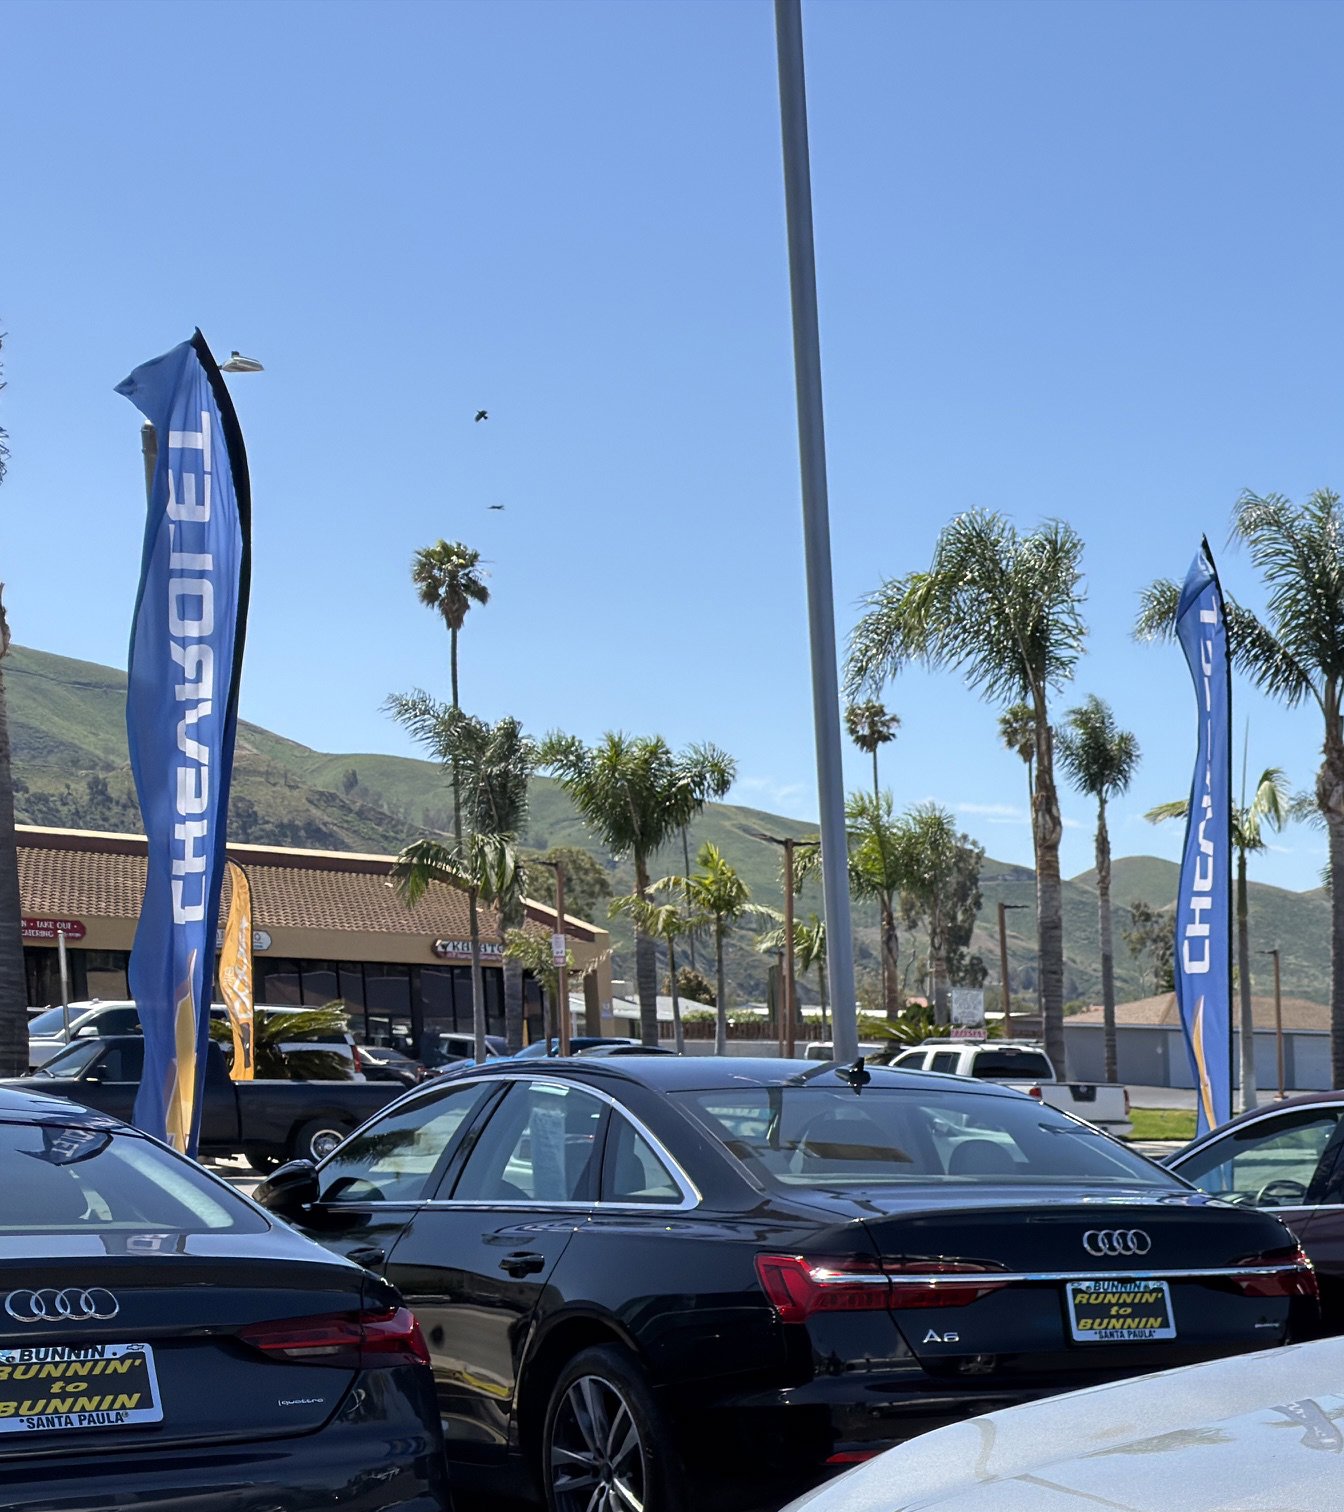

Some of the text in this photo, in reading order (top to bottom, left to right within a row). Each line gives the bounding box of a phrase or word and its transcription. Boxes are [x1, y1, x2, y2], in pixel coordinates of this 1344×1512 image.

[1093, 1281, 1142, 1292] BUNNIN
[1074, 1292, 1163, 1304] RUNNIN'
[1110, 1306, 1132, 1316] to
[1077, 1317, 1162, 1330] BUNNIN
[922, 1328, 960, 1343] A6
[1098, 1330, 1124, 1339] SANTA
[19, 1345, 106, 1362] BUNNIN
[50, 1381, 88, 1393] to
[0, 1393, 141, 1417] BUNNIN
[26, 1411, 125, 1429] SANTA PAULA
